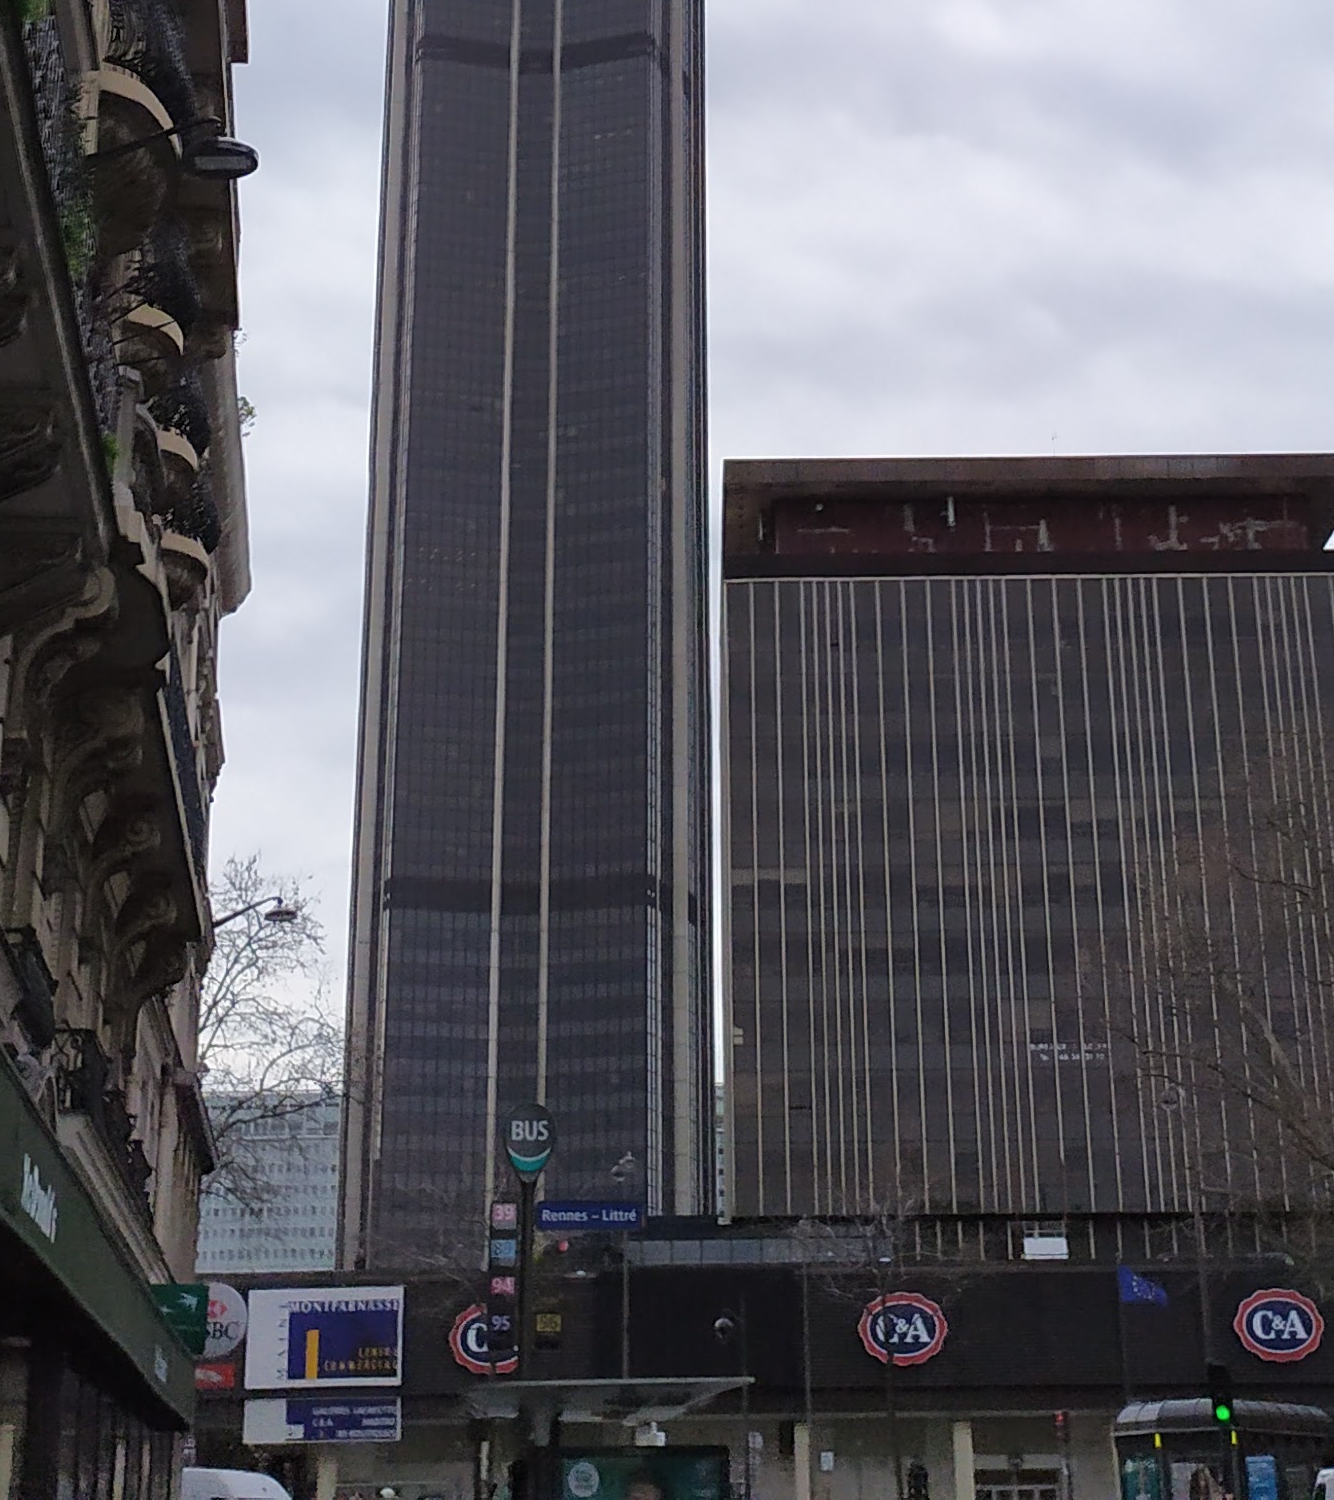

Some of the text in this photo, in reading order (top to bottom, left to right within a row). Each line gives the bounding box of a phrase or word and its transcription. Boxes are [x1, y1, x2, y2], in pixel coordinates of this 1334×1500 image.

[510, 1119, 549, 1141] BUS
[541, 1208, 589, 1222] Rennes
[602, 1207, 638, 1222] Littré
[491, 1276, 515, 1294] 94
[490, 1314, 511, 1332] 95
[875, 1312, 932, 1345] C&A
[1252, 1309, 1310, 1340] C&A
